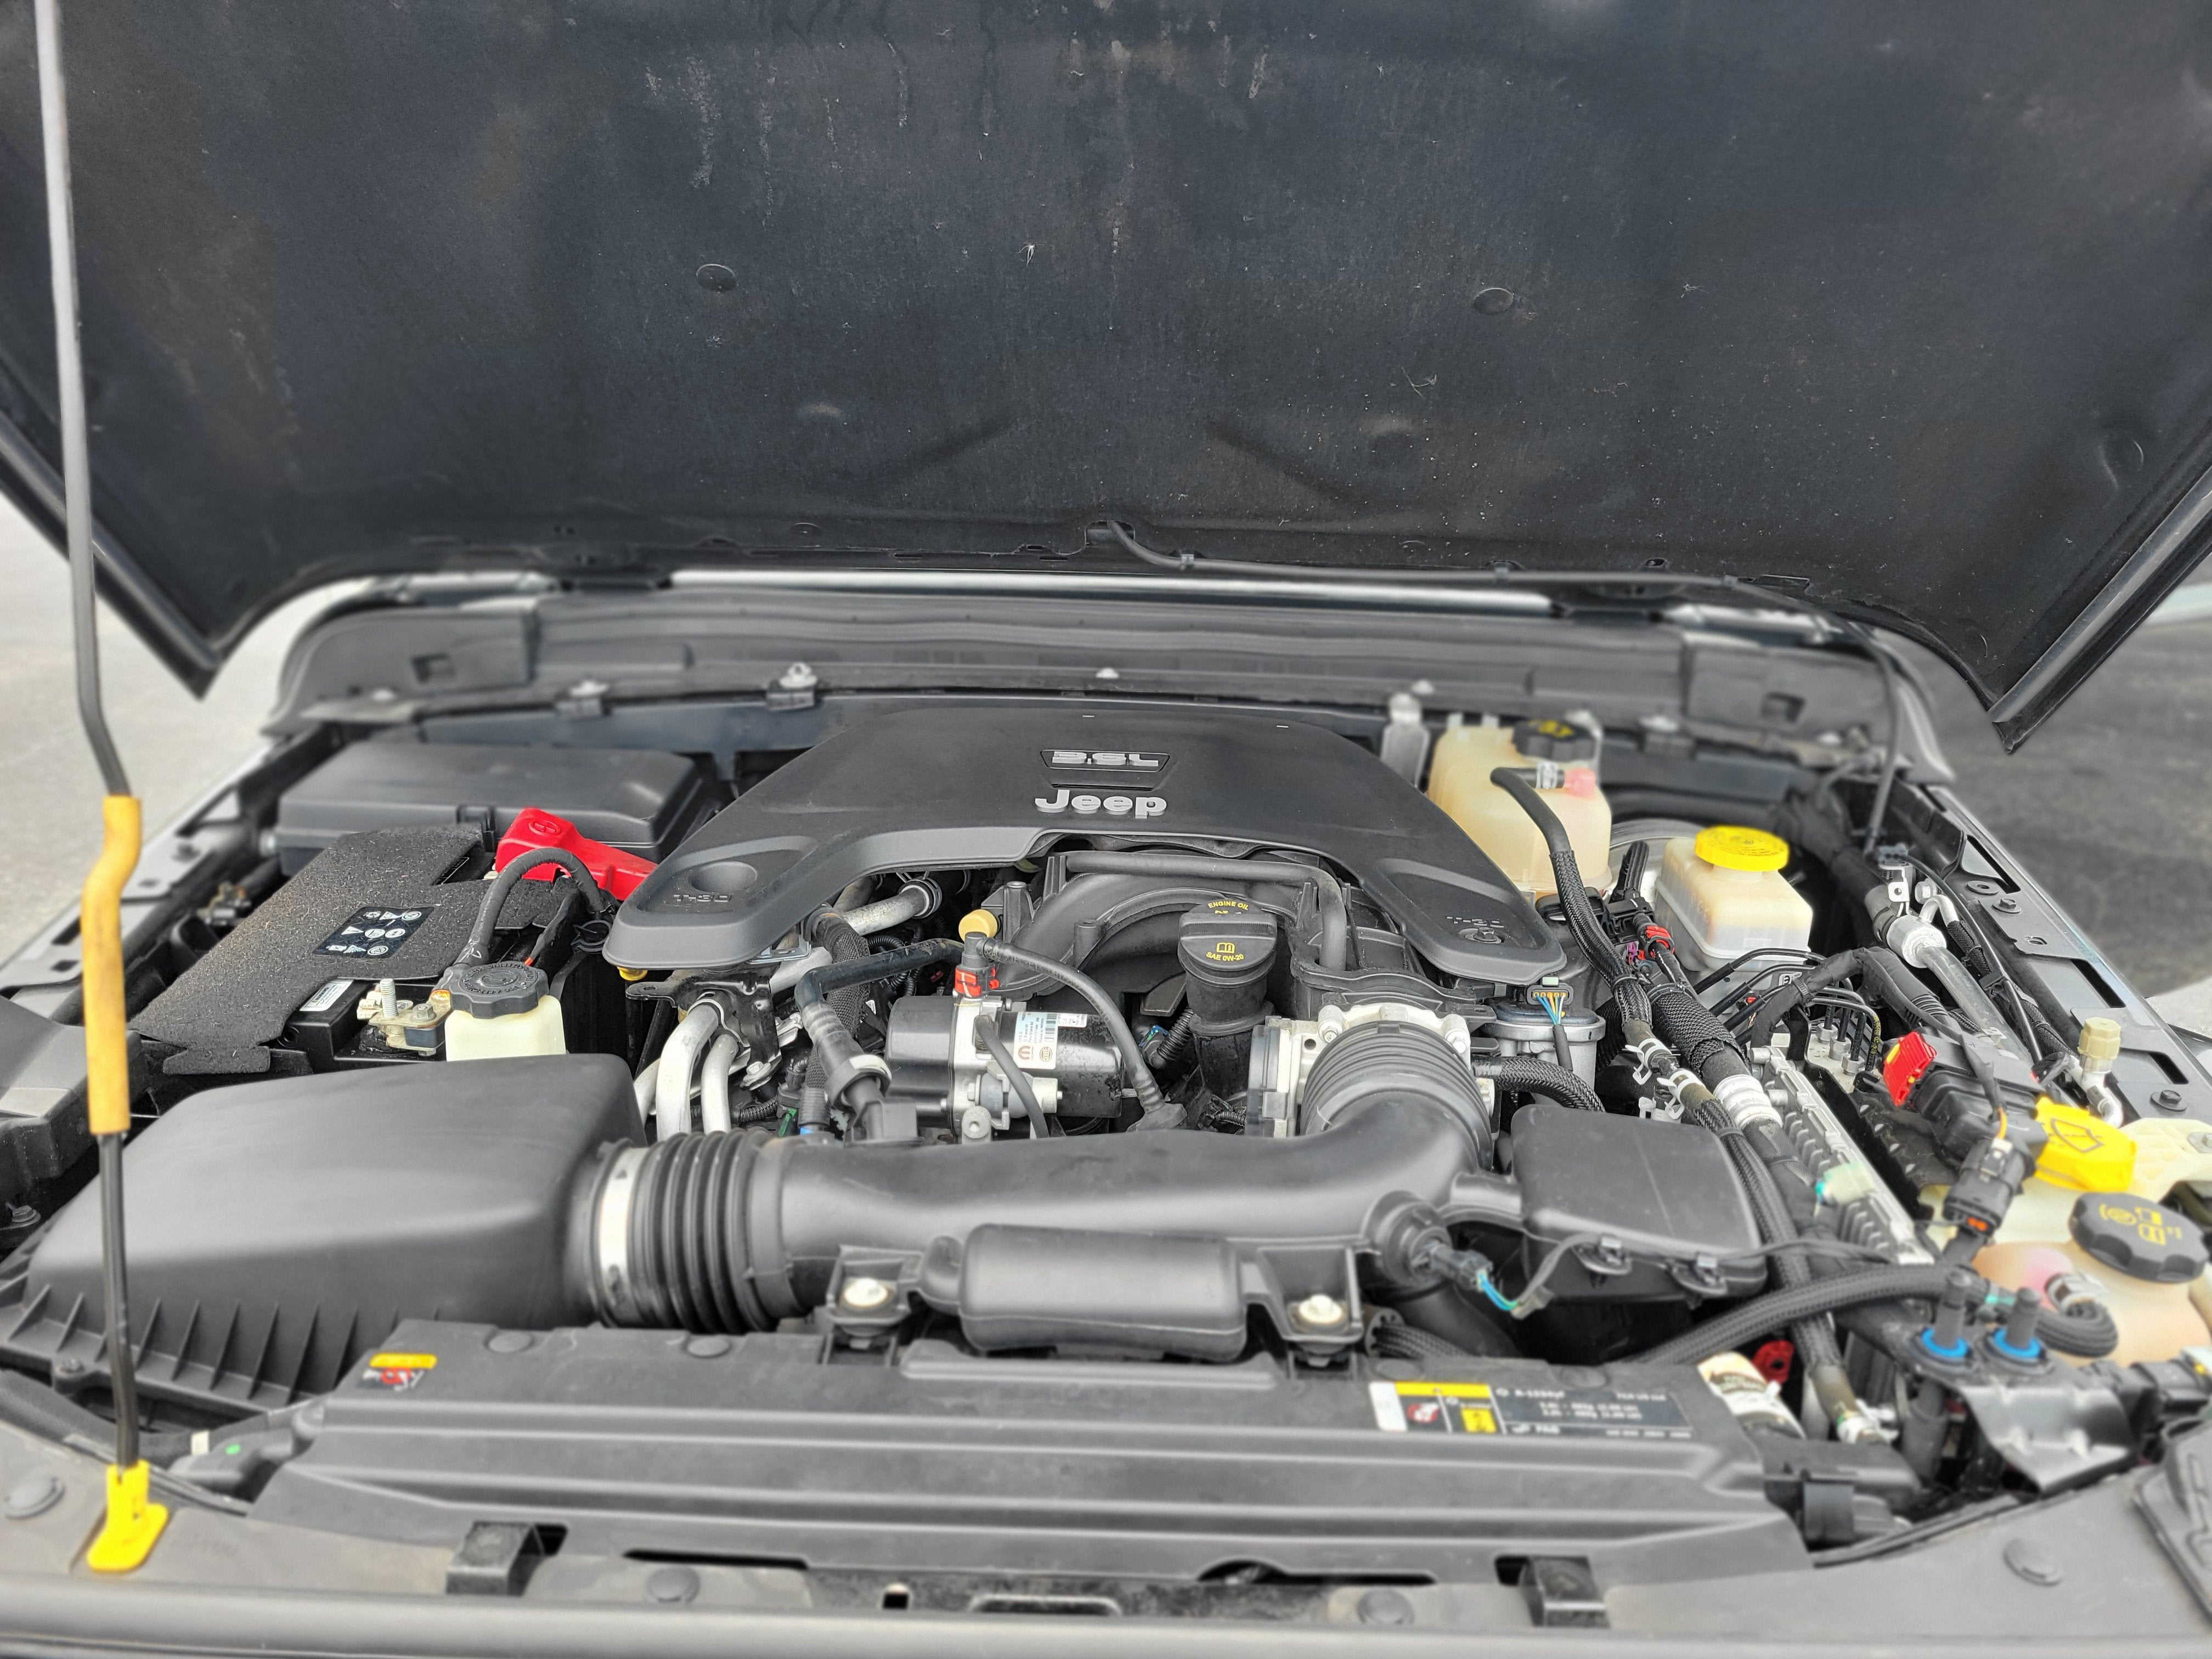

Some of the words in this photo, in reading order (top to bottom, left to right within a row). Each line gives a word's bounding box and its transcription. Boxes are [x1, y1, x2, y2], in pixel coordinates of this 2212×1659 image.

[1035, 789, 1167, 819] Jeep
[1207, 901, 1237, 909] ENGINE
[1237, 902, 1249, 911] OIL
[1206, 952, 1221, 961] SAE
